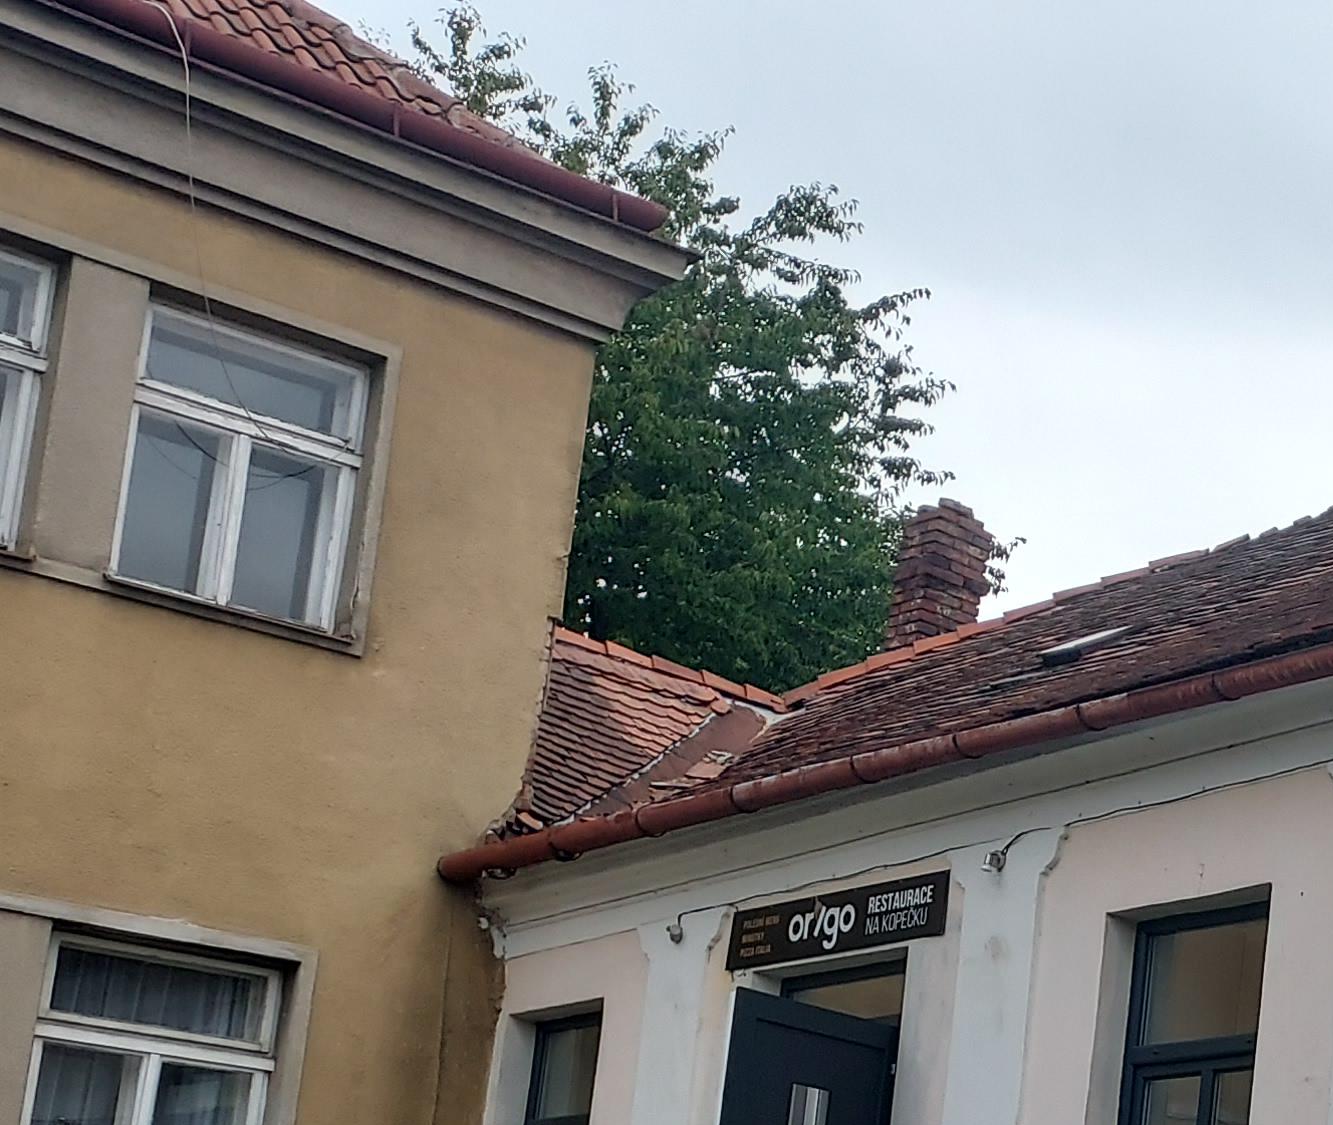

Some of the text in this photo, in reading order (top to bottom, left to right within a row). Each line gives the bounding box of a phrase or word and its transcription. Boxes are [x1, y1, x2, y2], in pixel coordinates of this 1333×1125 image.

[867, 885, 934, 914] RESTAURACE
[864, 906, 929, 935] NA KOPEČKU
